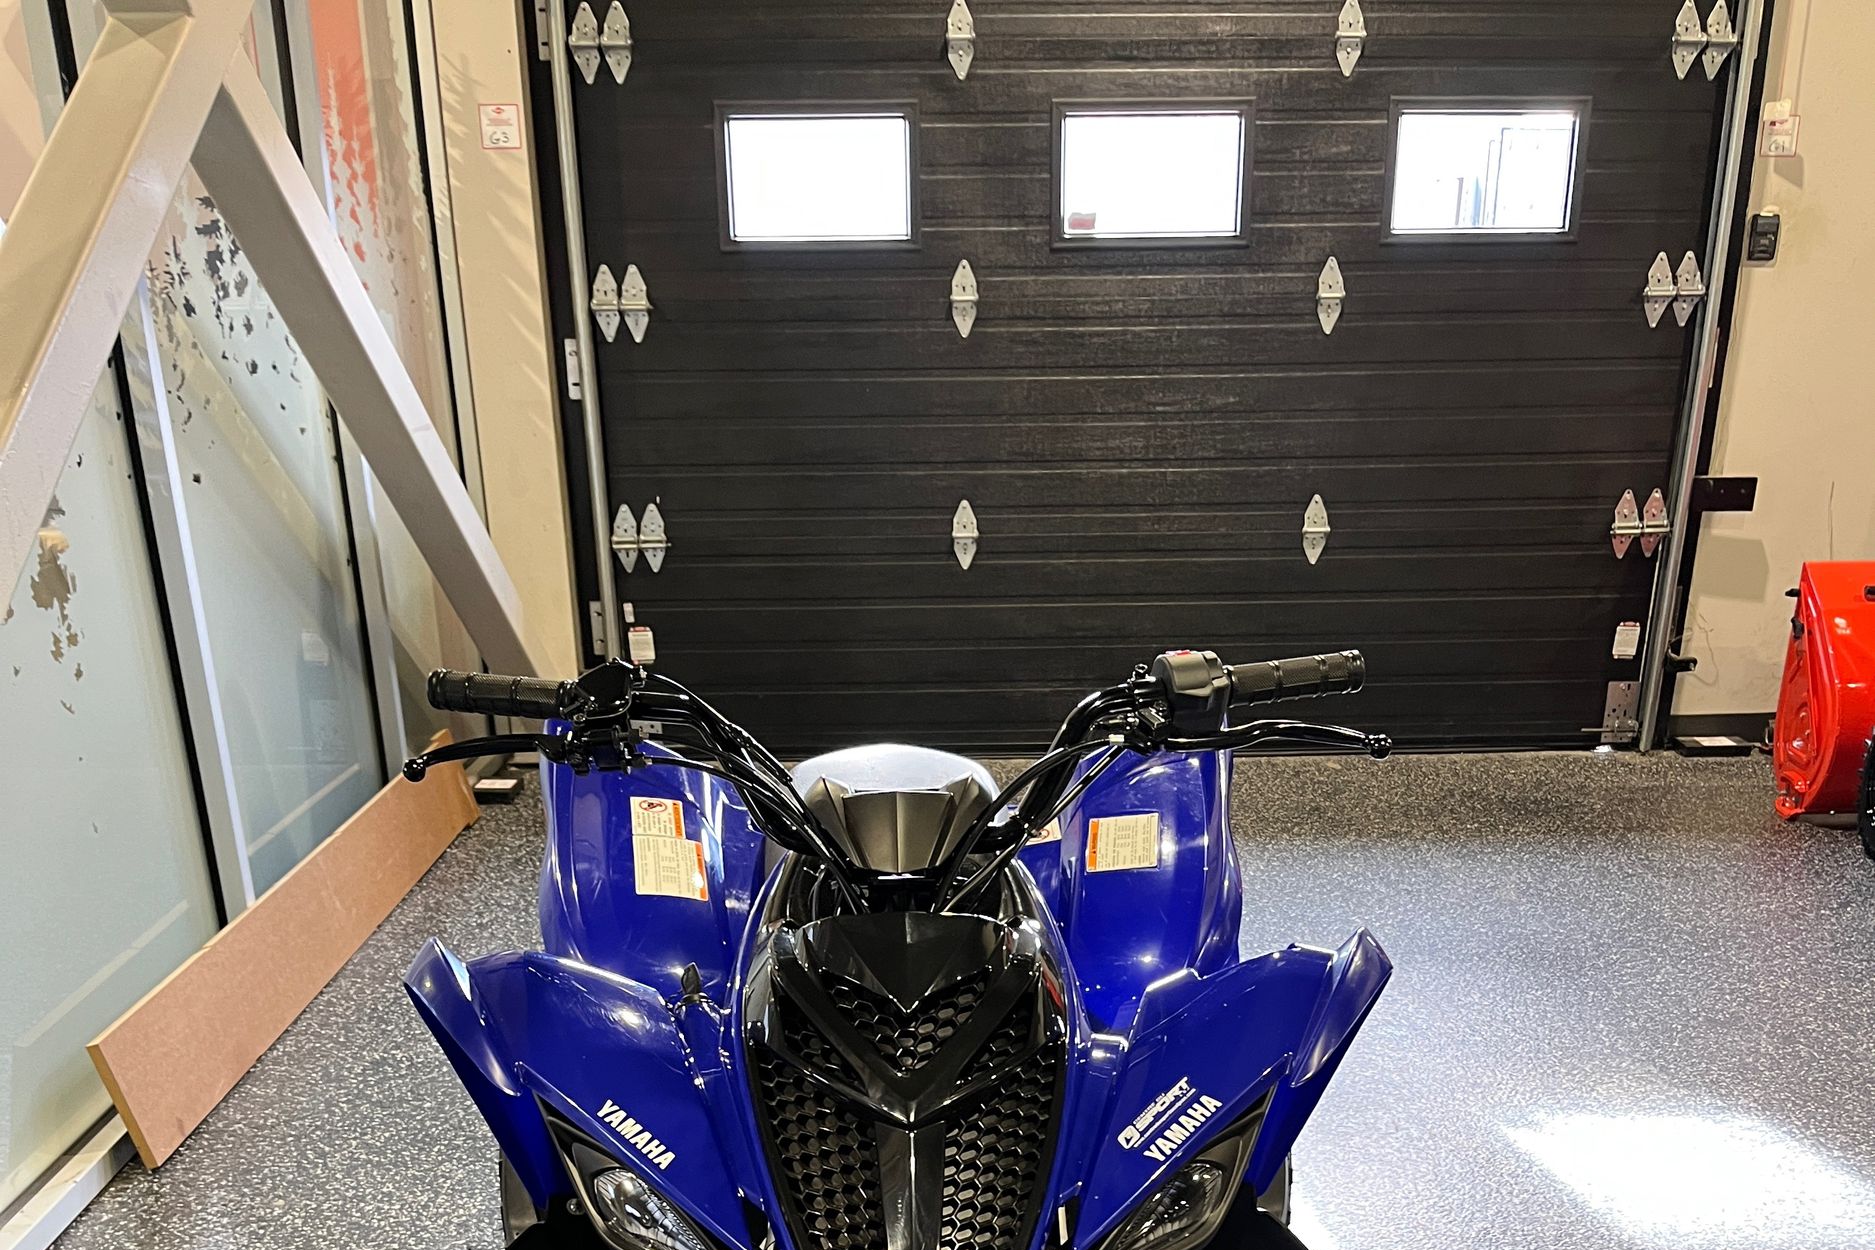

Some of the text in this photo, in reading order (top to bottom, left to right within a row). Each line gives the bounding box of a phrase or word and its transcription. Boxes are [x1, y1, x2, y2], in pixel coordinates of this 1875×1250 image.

[596, 1099, 676, 1170] YAMAHA
[1134, 1076, 1190, 1132] SPORT
[1143, 1095, 1223, 1162] YAMAHA
